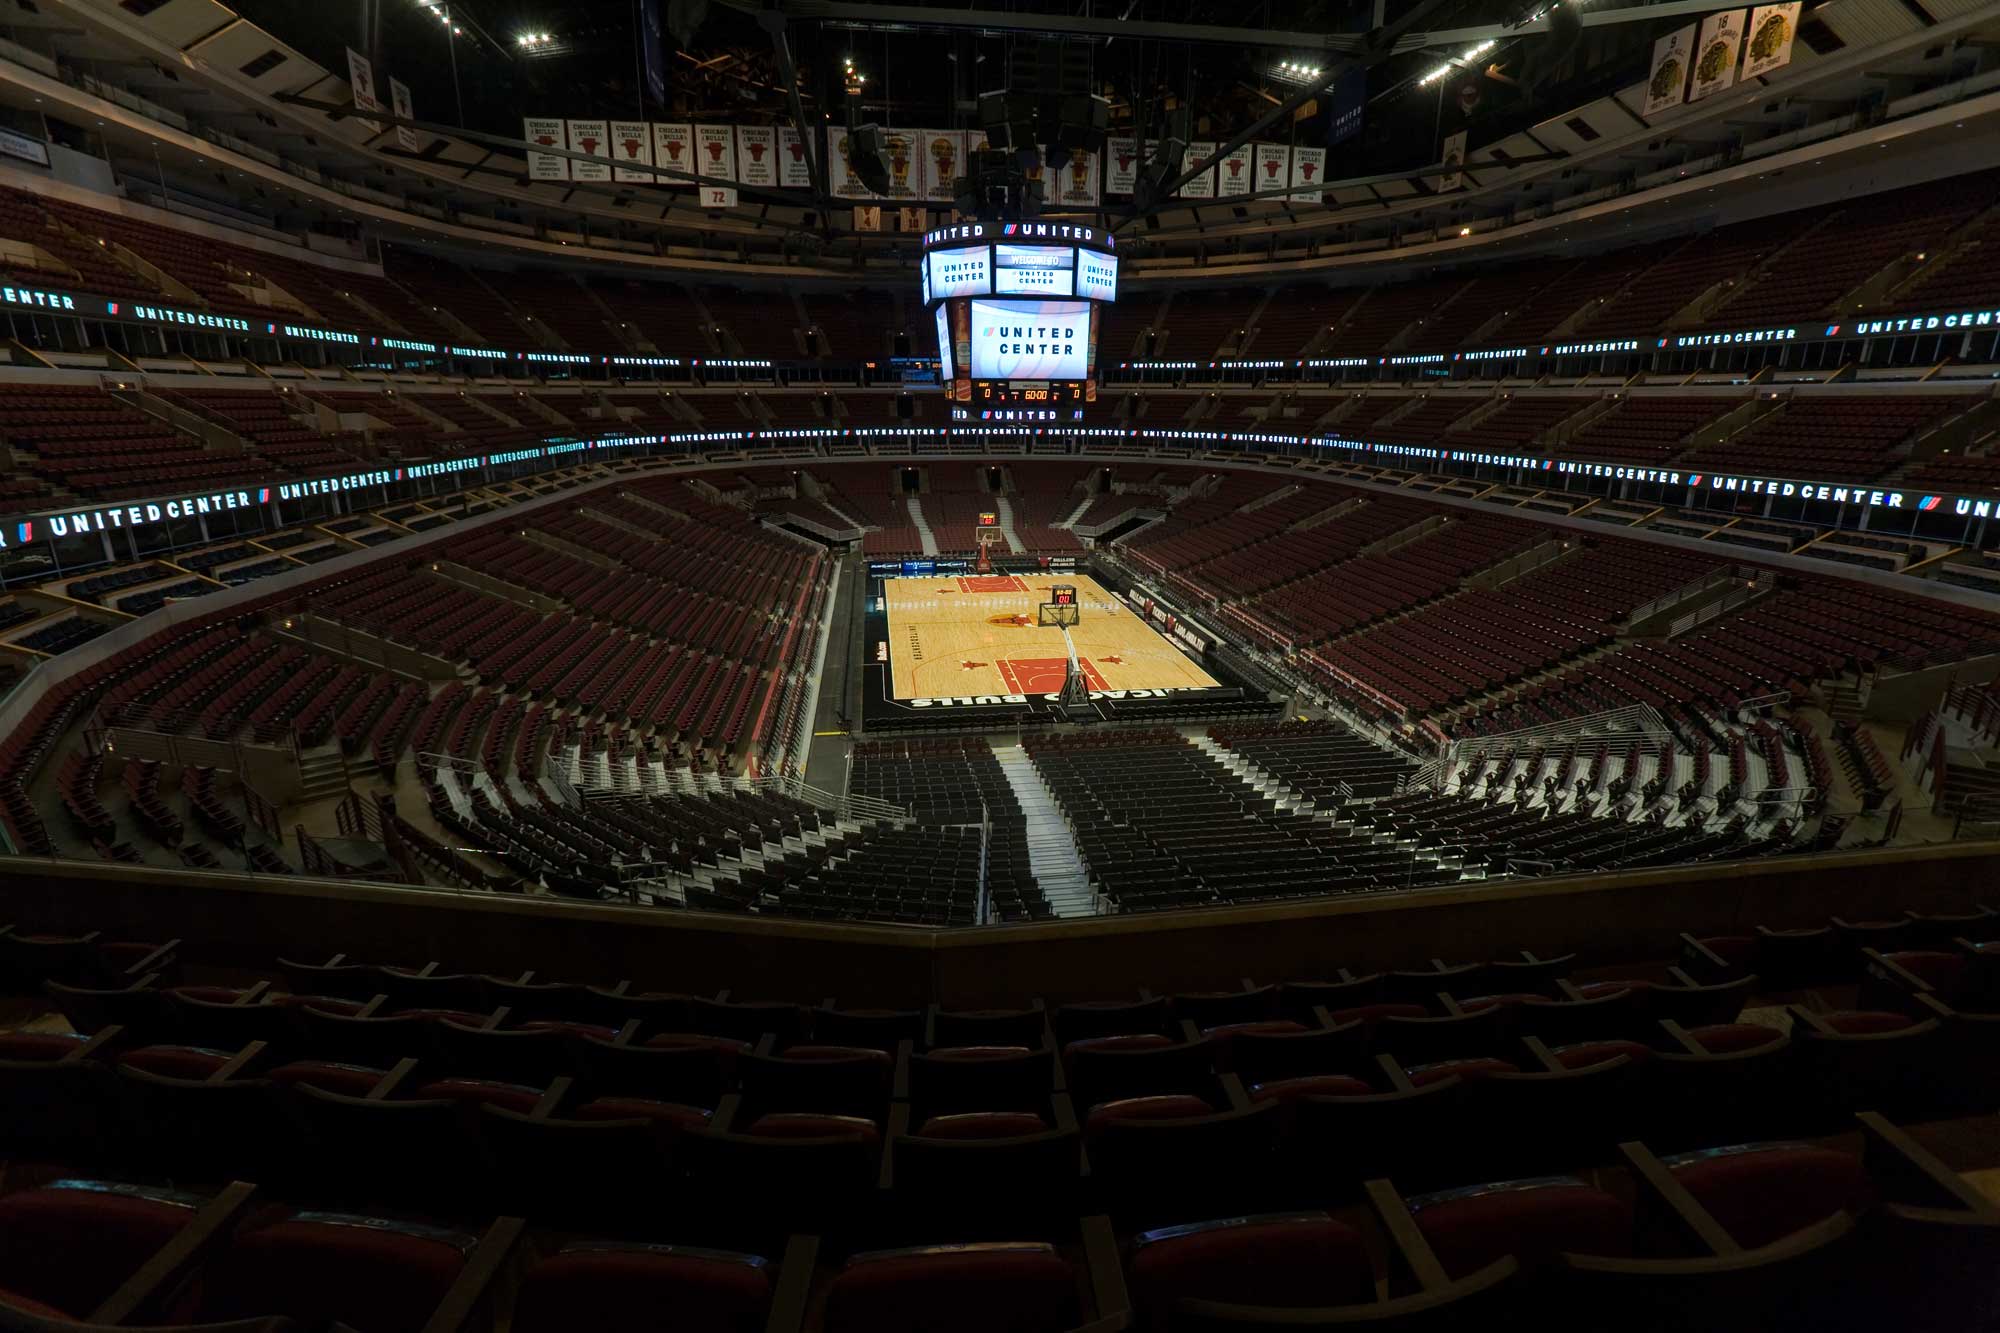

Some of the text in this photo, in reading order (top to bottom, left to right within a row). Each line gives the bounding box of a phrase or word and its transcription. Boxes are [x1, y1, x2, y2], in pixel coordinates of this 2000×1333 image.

[1718, 15, 1729, 29] 18
[529, 121, 559, 129] CHICAGO
[712, 191, 725, 203] 72
[929, 225, 983, 243] UNITED
[1022, 224, 1092, 240] UNITED
[944, 262, 984, 272] UNITED
[1087, 265, 1113, 277] UNITED
[944, 273, 984, 283] CENTER
[1086, 276, 1113, 287] CENTER
[0, 287, 75, 310] ENTER
[136, 306, 248, 330] UNITED CENTER
[1858, 311, 2000, 333] UNITED CEN
[1000, 327, 1073, 339] UNITED
[1679, 329, 1795, 346] UNITED CENTER
[1000, 343, 1073, 355] CENTER
[1556, 340, 1637, 354] UNITED CENTER
[1466, 348, 1526, 360] UNITED CENTER
[1341, 358, 1367, 366] CENTER
[985, 389, 991, 398] 0
[1074, 389, 1080, 399] 0
[995, 410, 1056, 419] UNITED
[671, 432, 742, 442] UNITED CENTER
[760, 430, 797, 438] UNITED
[1089, 428, 1125, 436] CENTER
[1182, 431, 1217, 439] CENTER
[1232, 433, 1298, 443] UNITED CENTER
[597, 436, 656, 447] UNITED CENTER
[1312, 438, 1363, 449] UNITED CENTER
[1375, 444, 1437, 458] UNITED CENTER
[1453, 451, 1536, 468] UNITED CENTER
[408, 458, 478, 478] UNITED CENTER
[1559, 462, 1679, 484] UNITED CENTER
[280, 471, 390, 499] UNITED CENTER
[1713, 477, 1902, 507] UNITED CENTER
[49, 492, 249, 536] UNITED CENTER
[1956, 499, 2000, 518] UNI
[1058, 595, 1070, 604] 00
[911, 694, 1027, 707] BULLS
